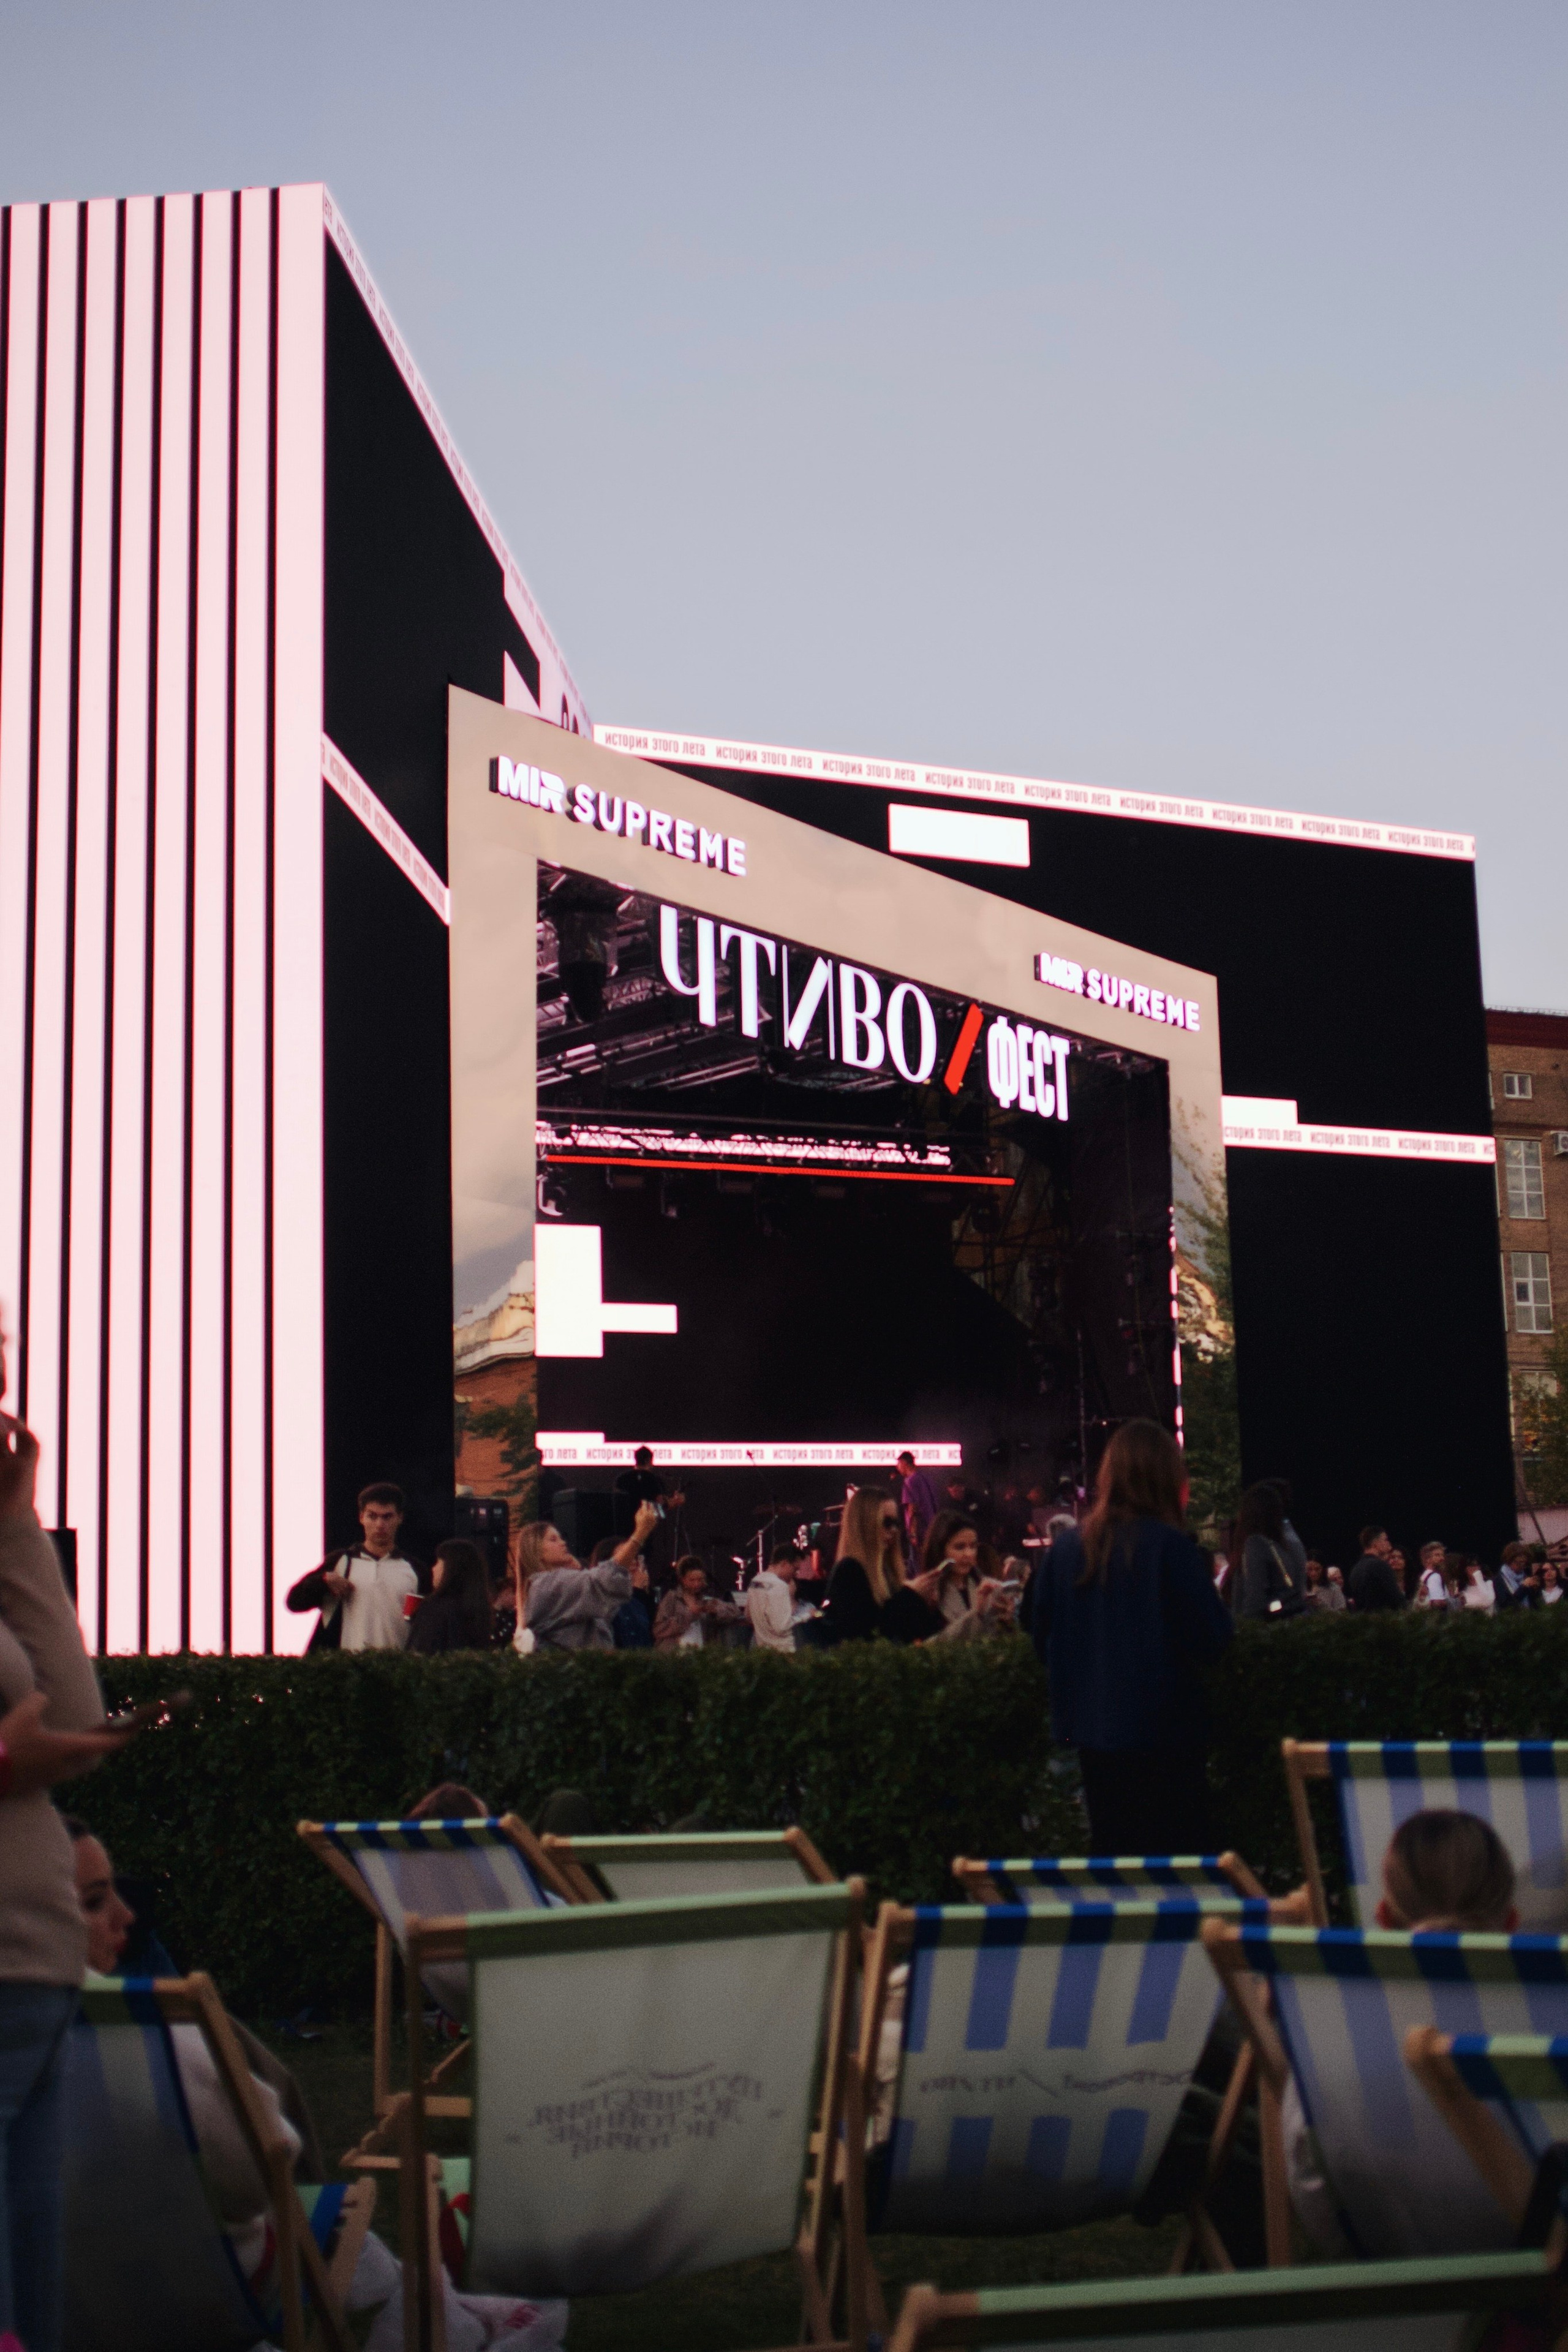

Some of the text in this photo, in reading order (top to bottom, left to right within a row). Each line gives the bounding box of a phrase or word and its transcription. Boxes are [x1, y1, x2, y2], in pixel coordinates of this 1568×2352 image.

[496, 755, 747, 877] MIR SUPREME
[605, 732, 648, 750] история
[652, 738, 679, 753] этого
[682, 741, 706, 756] лета
[716, 745, 757, 763] история
[761, 751, 787, 766] этого
[791, 753, 813, 769] лета
[823, 758, 862, 776] история
[866, 764, 891, 779] этого
[894, 767, 916, 782] лета
[925, 771, 964, 789] история
[967, 776, 991, 791] этого
[994, 780, 1016, 795] лета
[1024, 784, 1061, 802] история
[1065, 790, 1088, 804] этого
[1091, 793, 1111, 807] лета
[1120, 796, 1156, 813] история
[1159, 801, 1182, 816] этого
[1184, 804, 1204, 818] лета
[1212, 808, 1247, 824] история
[1250, 813, 1272, 827] этого
[1275, 815, 1294, 830] лета
[1302, 819, 1336, 835] история
[1338, 823, 1360, 837] этого
[1362, 826, 1381, 840] лета
[1388, 831, 1421, 845] история
[1423, 835, 1444, 848] этого
[1447, 837, 1464, 851] лета
[660, 903, 937, 1083] ЧТИВО
[987, 1015, 1070, 1121] ФЕСТ
[1086, 968, 1201, 1032] SUPREME
[1224, 1126, 1254, 1140] стория
[1257, 1128, 1280, 1141] этого
[1283, 1130, 1302, 1143] лета
[1310, 1131, 1345, 1147] история
[557, 1449, 577, 1459] лета
[586, 1449, 624, 1461] история
[681, 1449, 717, 1461] история
[720, 1449, 742, 1459] этого
[773, 1449, 808, 1462] история
[810, 1449, 832, 1459] этого
